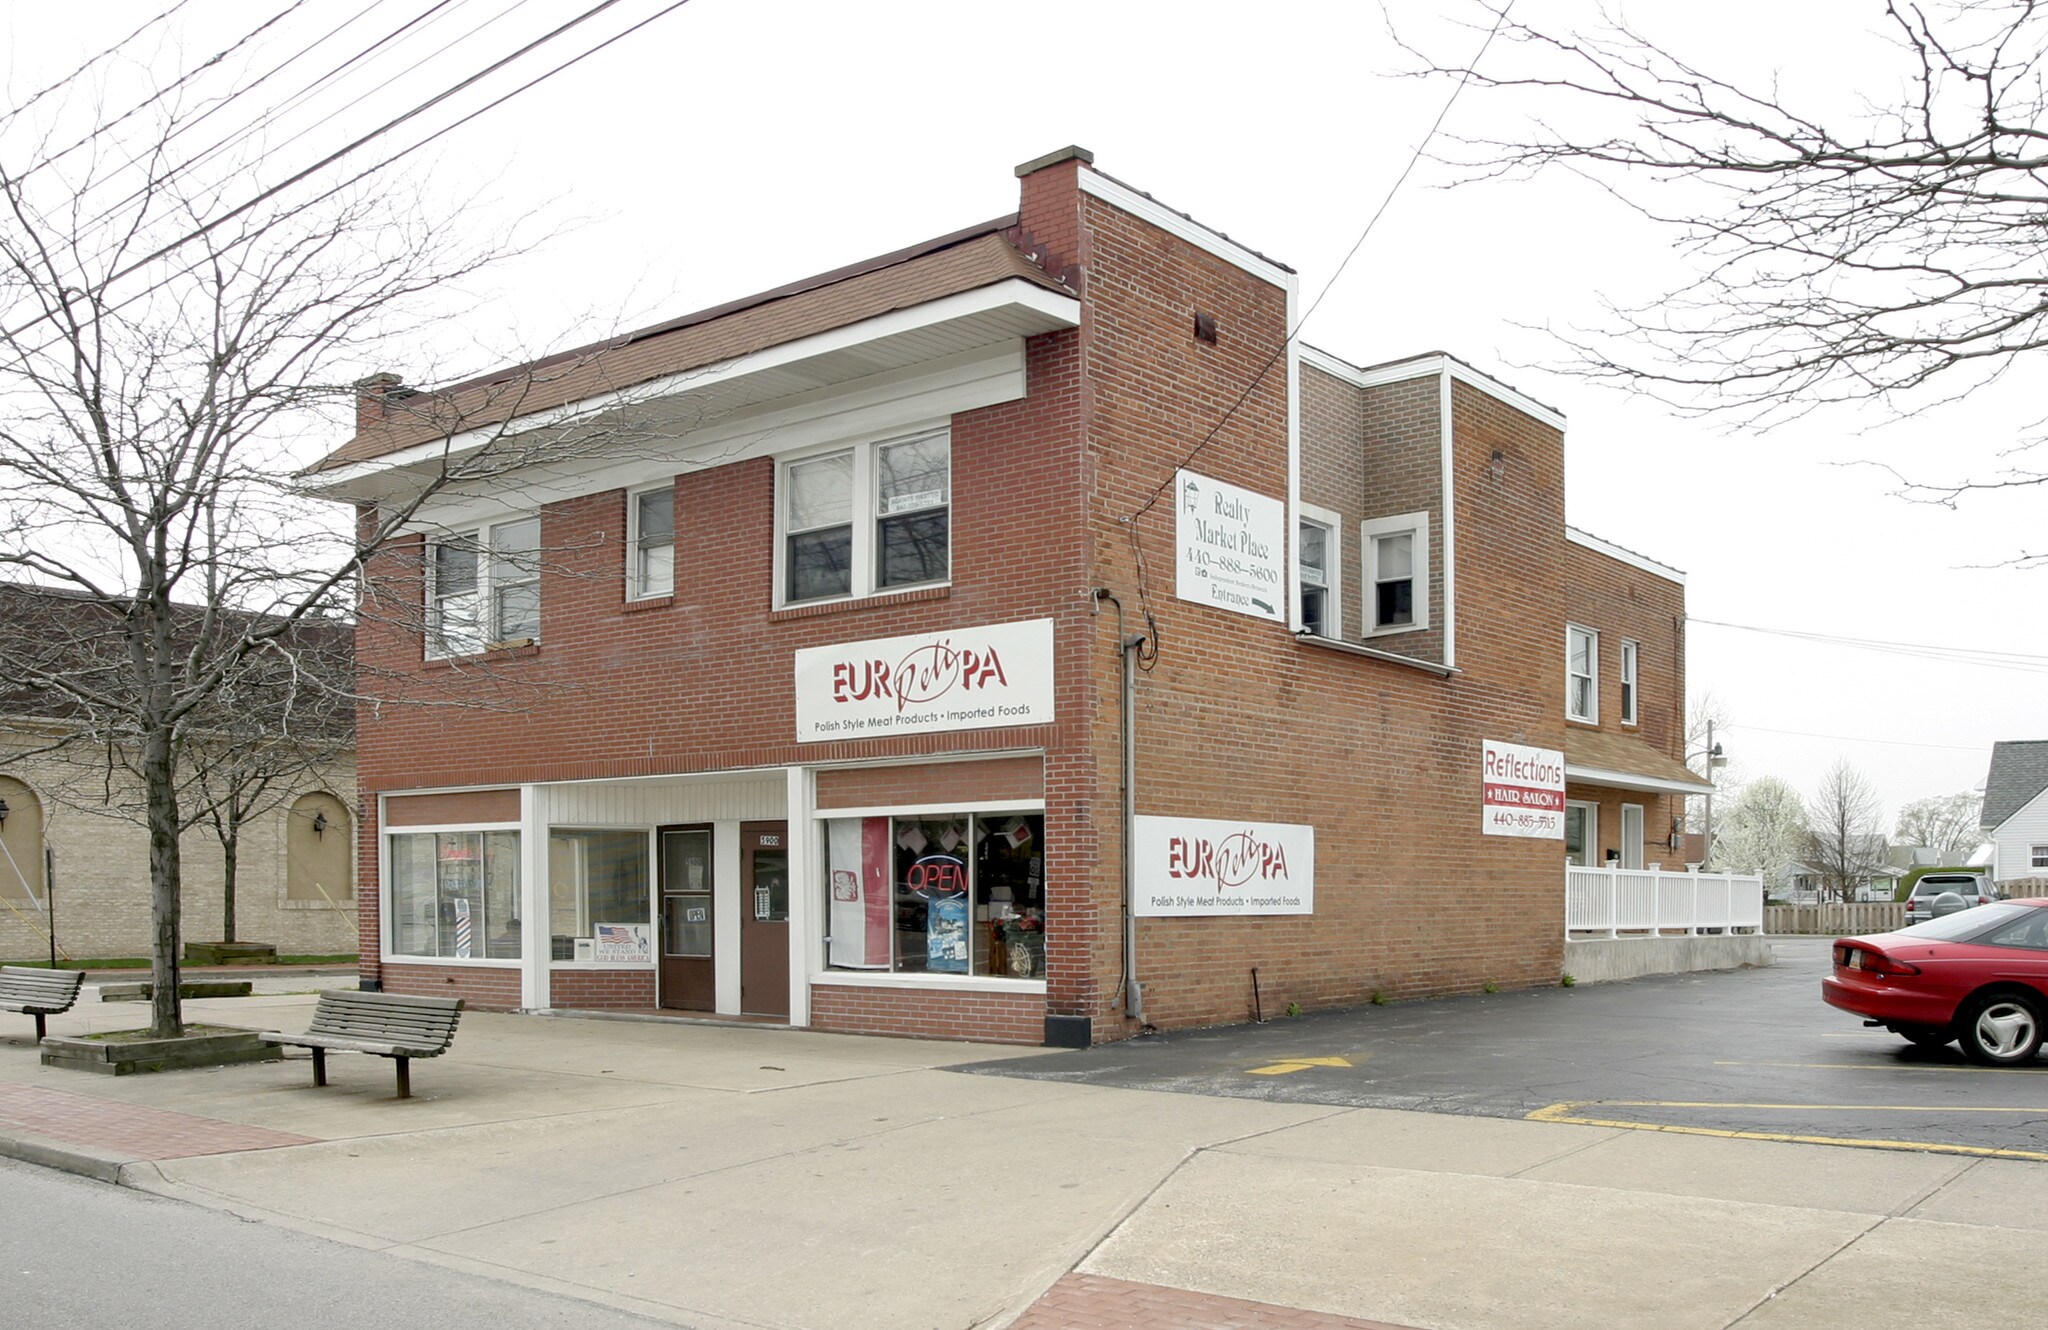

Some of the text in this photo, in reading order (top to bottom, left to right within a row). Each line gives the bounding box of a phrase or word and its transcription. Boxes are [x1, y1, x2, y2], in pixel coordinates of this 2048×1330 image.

[1214, 491, 1251, 528] Realty
[1195, 518, 1270, 560] Market Place
[1185, 546, 1278, 584] 440-888-5600
[1211, 583, 1250, 607] Entrance
[814, 703, 1031, 732] Polish Style Meat Products Imported Foods
[1485, 750, 1561, 784] Reflections
[1494, 788, 1553, 806] HAIR SALON
[907, 864, 969, 892] OPEN
[688, 909, 705, 921] OPEN
[1151, 895, 1301, 907] Polish Style Meat Products Imported Foods
